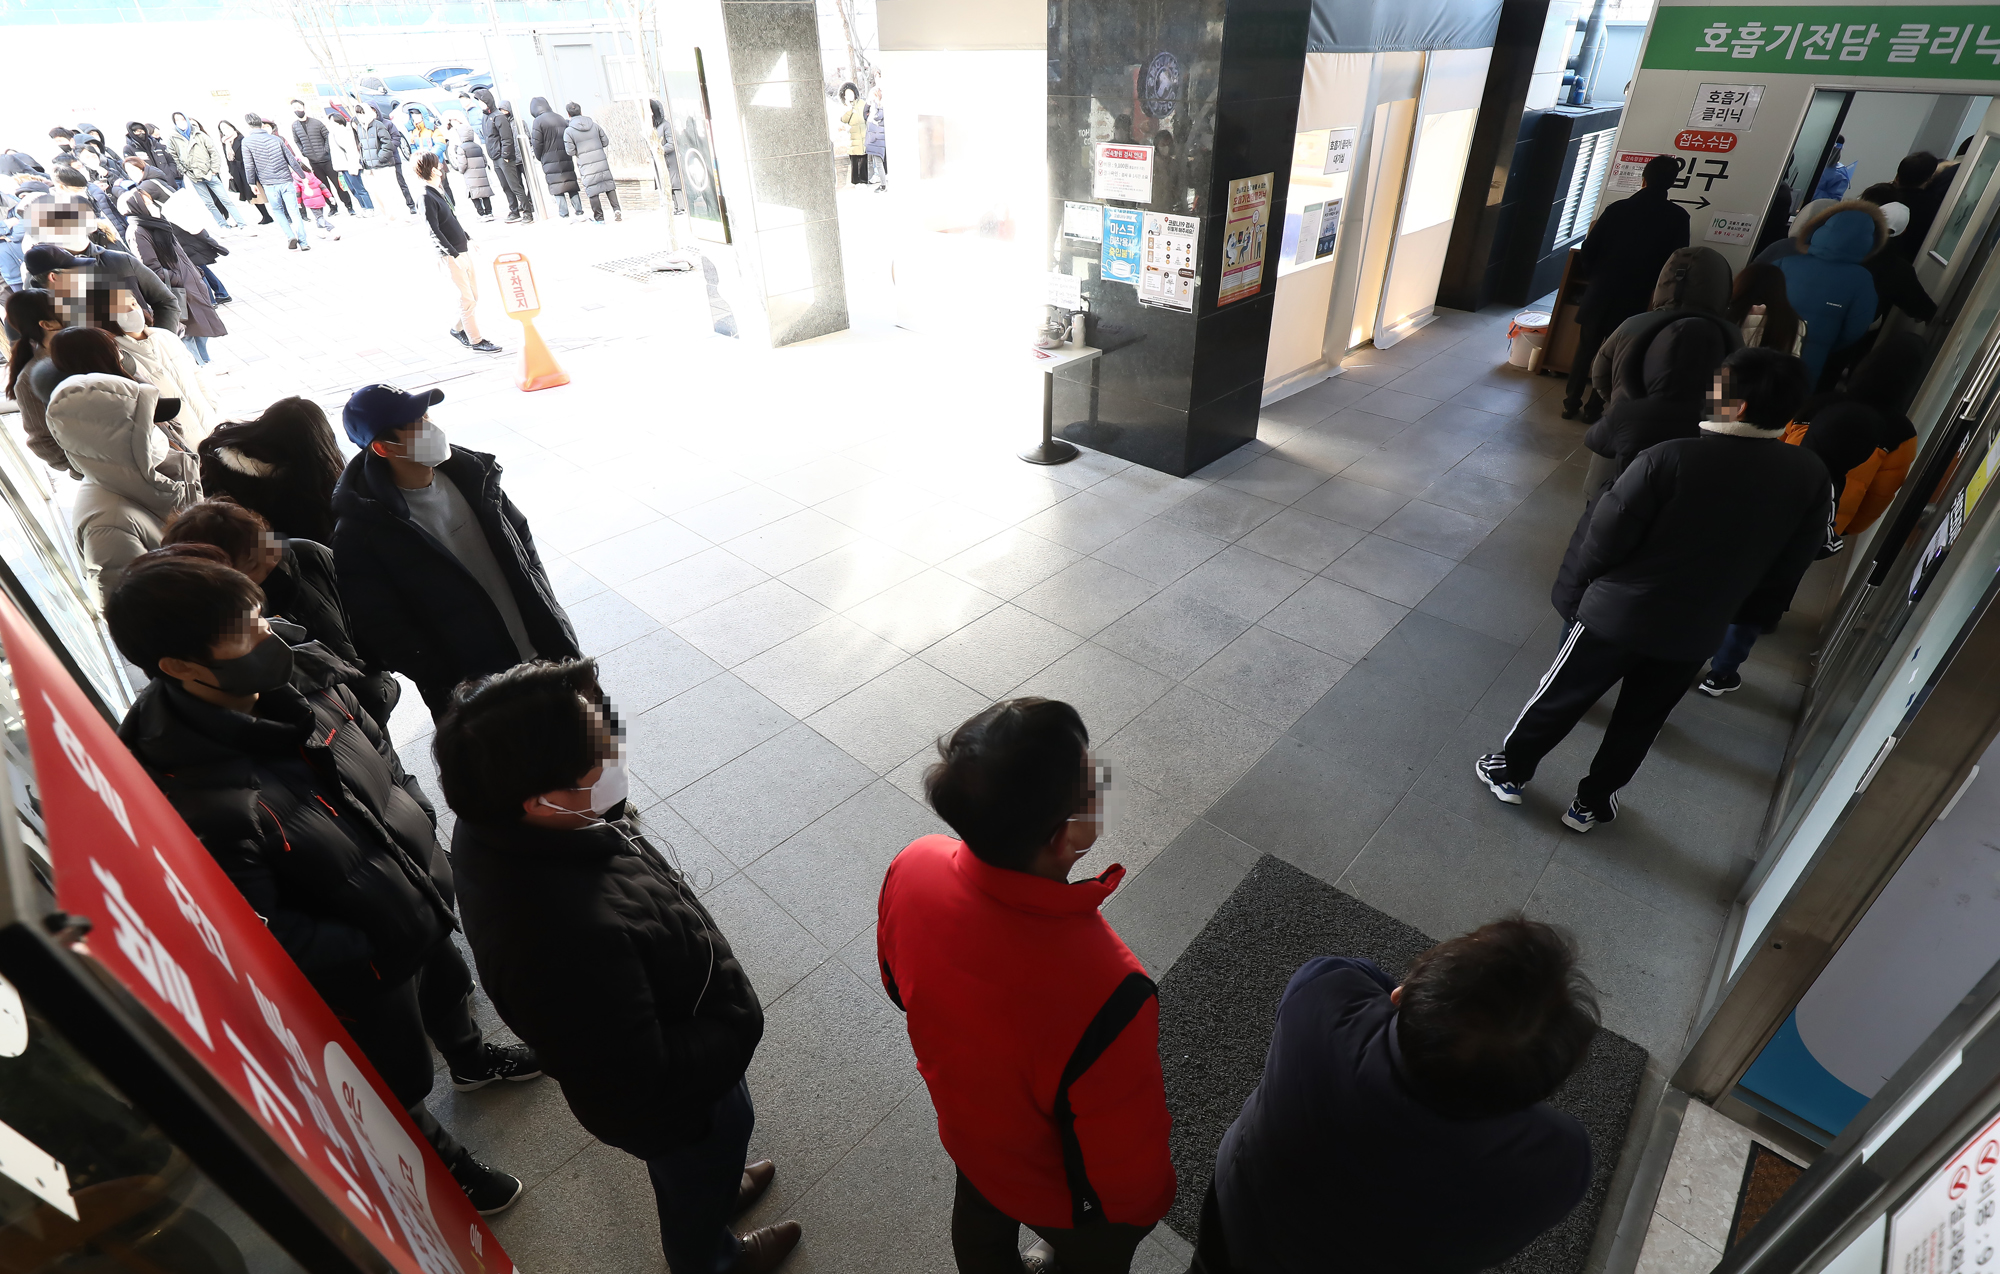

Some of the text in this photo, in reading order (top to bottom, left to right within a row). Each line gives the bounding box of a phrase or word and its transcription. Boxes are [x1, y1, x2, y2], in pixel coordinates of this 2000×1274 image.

[1695, 22, 1880, 61] 호흡기전담
[1706, 90, 1750, 106] 호흡기
[1702, 107, 1744, 123] 클리닉
[1680, 133, 1733, 149] 접수,수납
[1671, 157, 1729, 191] 입구
[1110, 222, 1135, 236] 마스크
[506, 264, 528, 309] 주차금지
